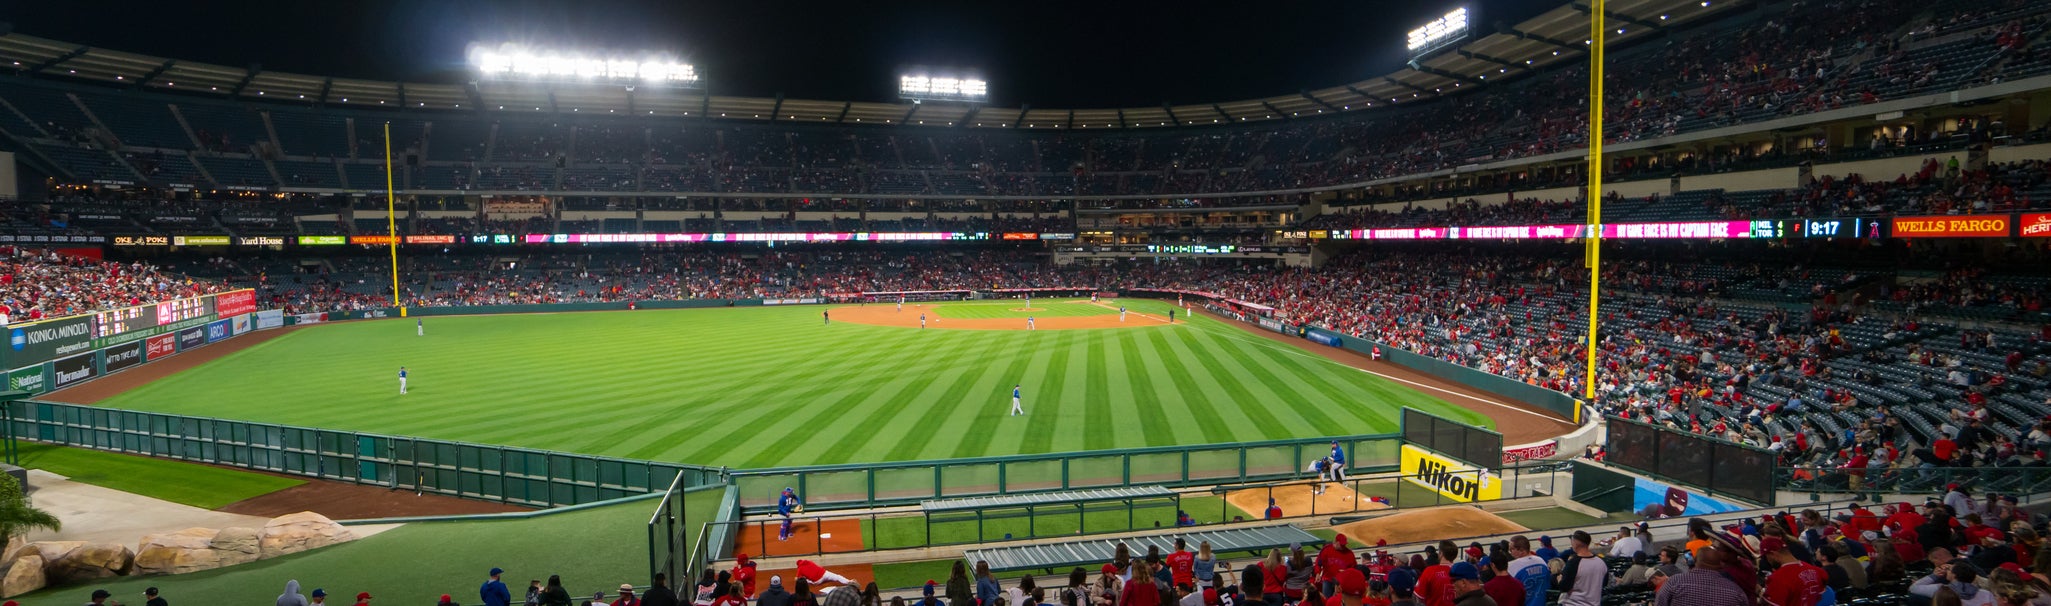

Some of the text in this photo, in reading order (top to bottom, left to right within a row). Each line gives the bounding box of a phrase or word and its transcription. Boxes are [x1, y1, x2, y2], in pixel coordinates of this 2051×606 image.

[1710, 222, 1728, 237] FACE
[1758, 220, 1772, 229] MIL
[1811, 221, 1839, 235] 9:17
[1896, 219, 2004, 232] WELLS FARGO
[115, 236, 168, 244] OKE POKE
[1758, 229, 1773, 238] TOR
[240, 236, 283, 246] Yard House
[28, 328, 58, 344] KONICA
[59, 322, 89, 338] MINOLTA
[210, 323, 224, 339] ARCO
[106, 353, 121, 365] NITTO
[17, 371, 43, 388] National
[56, 365, 90, 385] Thermador
[1417, 457, 1478, 502] Nikon
[1220, 592, 1234, 606] 5
